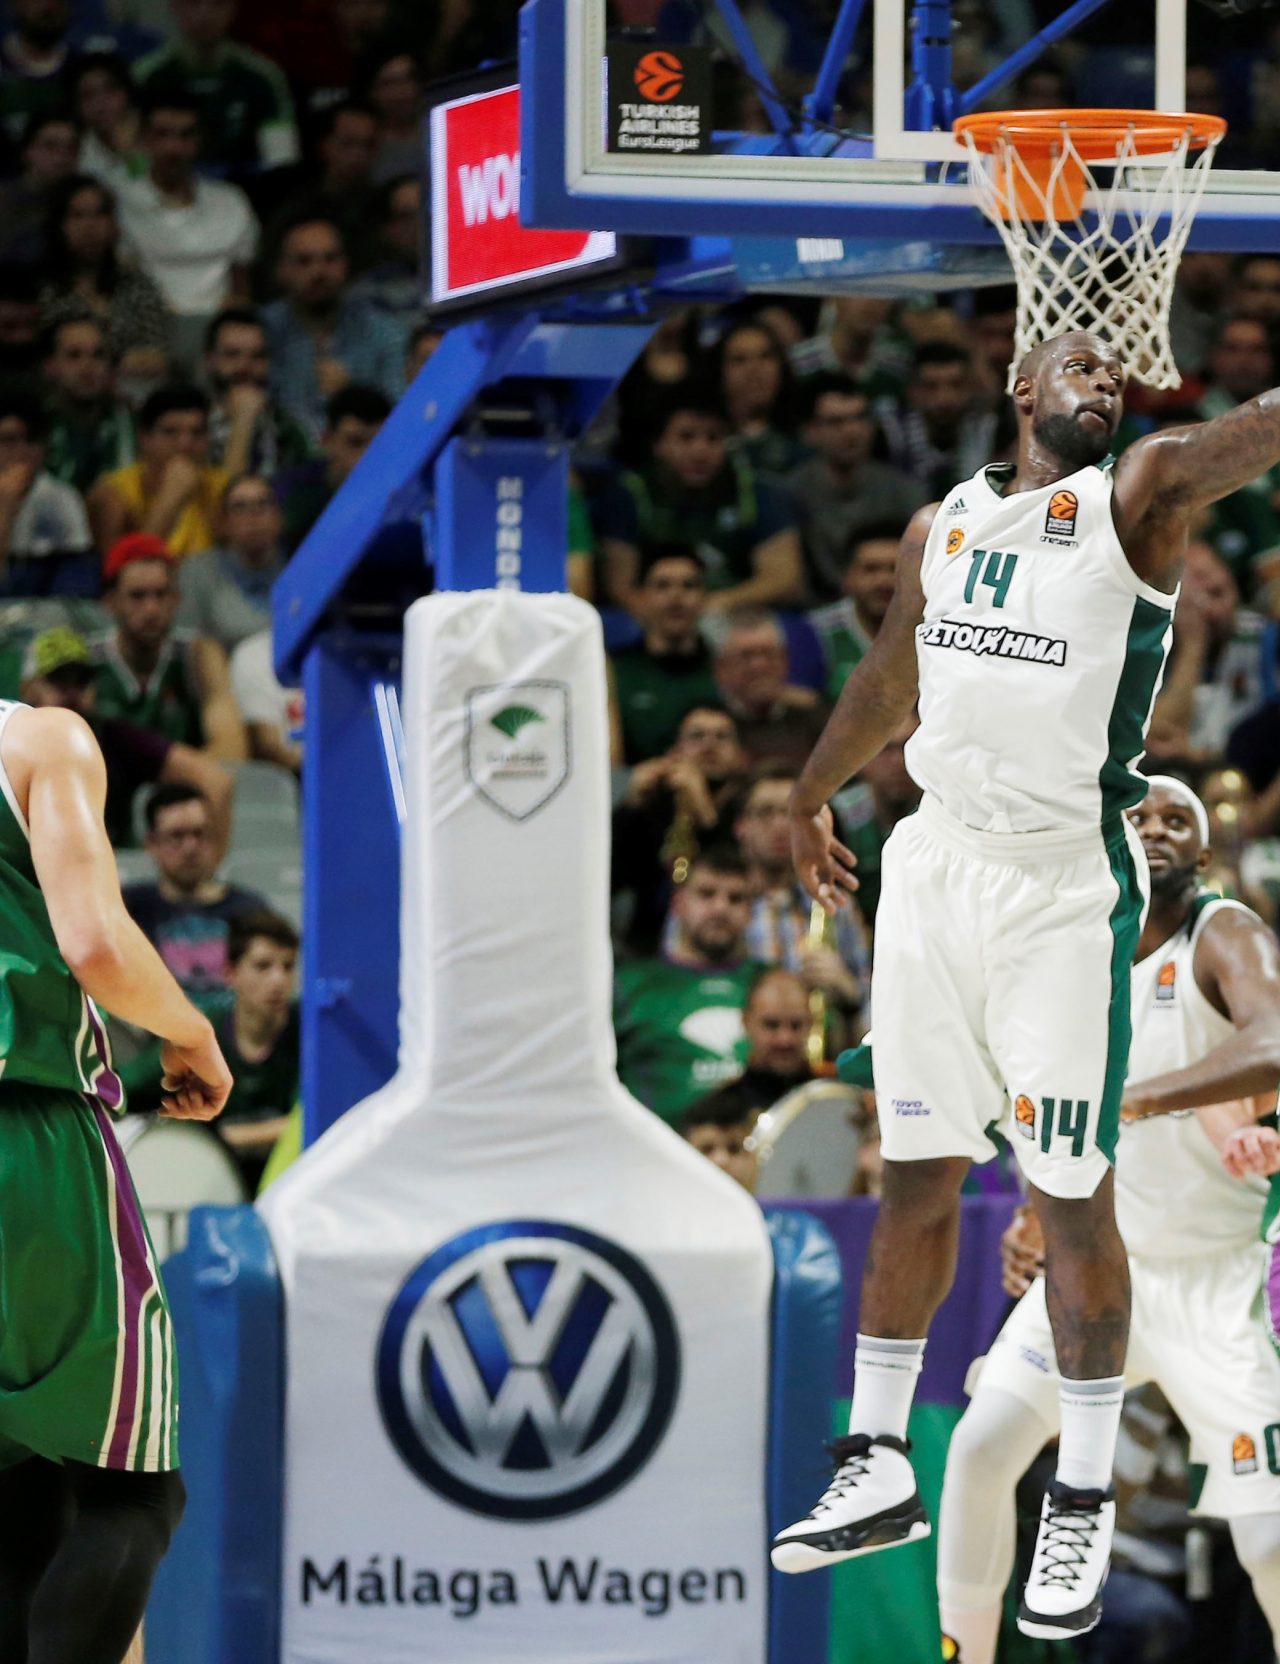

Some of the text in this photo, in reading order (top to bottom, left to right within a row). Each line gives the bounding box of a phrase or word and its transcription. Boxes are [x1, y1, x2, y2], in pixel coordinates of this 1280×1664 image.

[619, 104, 700, 119] TURKISH
[619, 119, 700, 135] AIRLINES
[618, 134, 700, 152] EuroLeague
[963, 549, 1018, 608] 14
[1041, 1097, 1089, 1157] 14
[301, 1553, 746, 1619] Málaga Wagen
